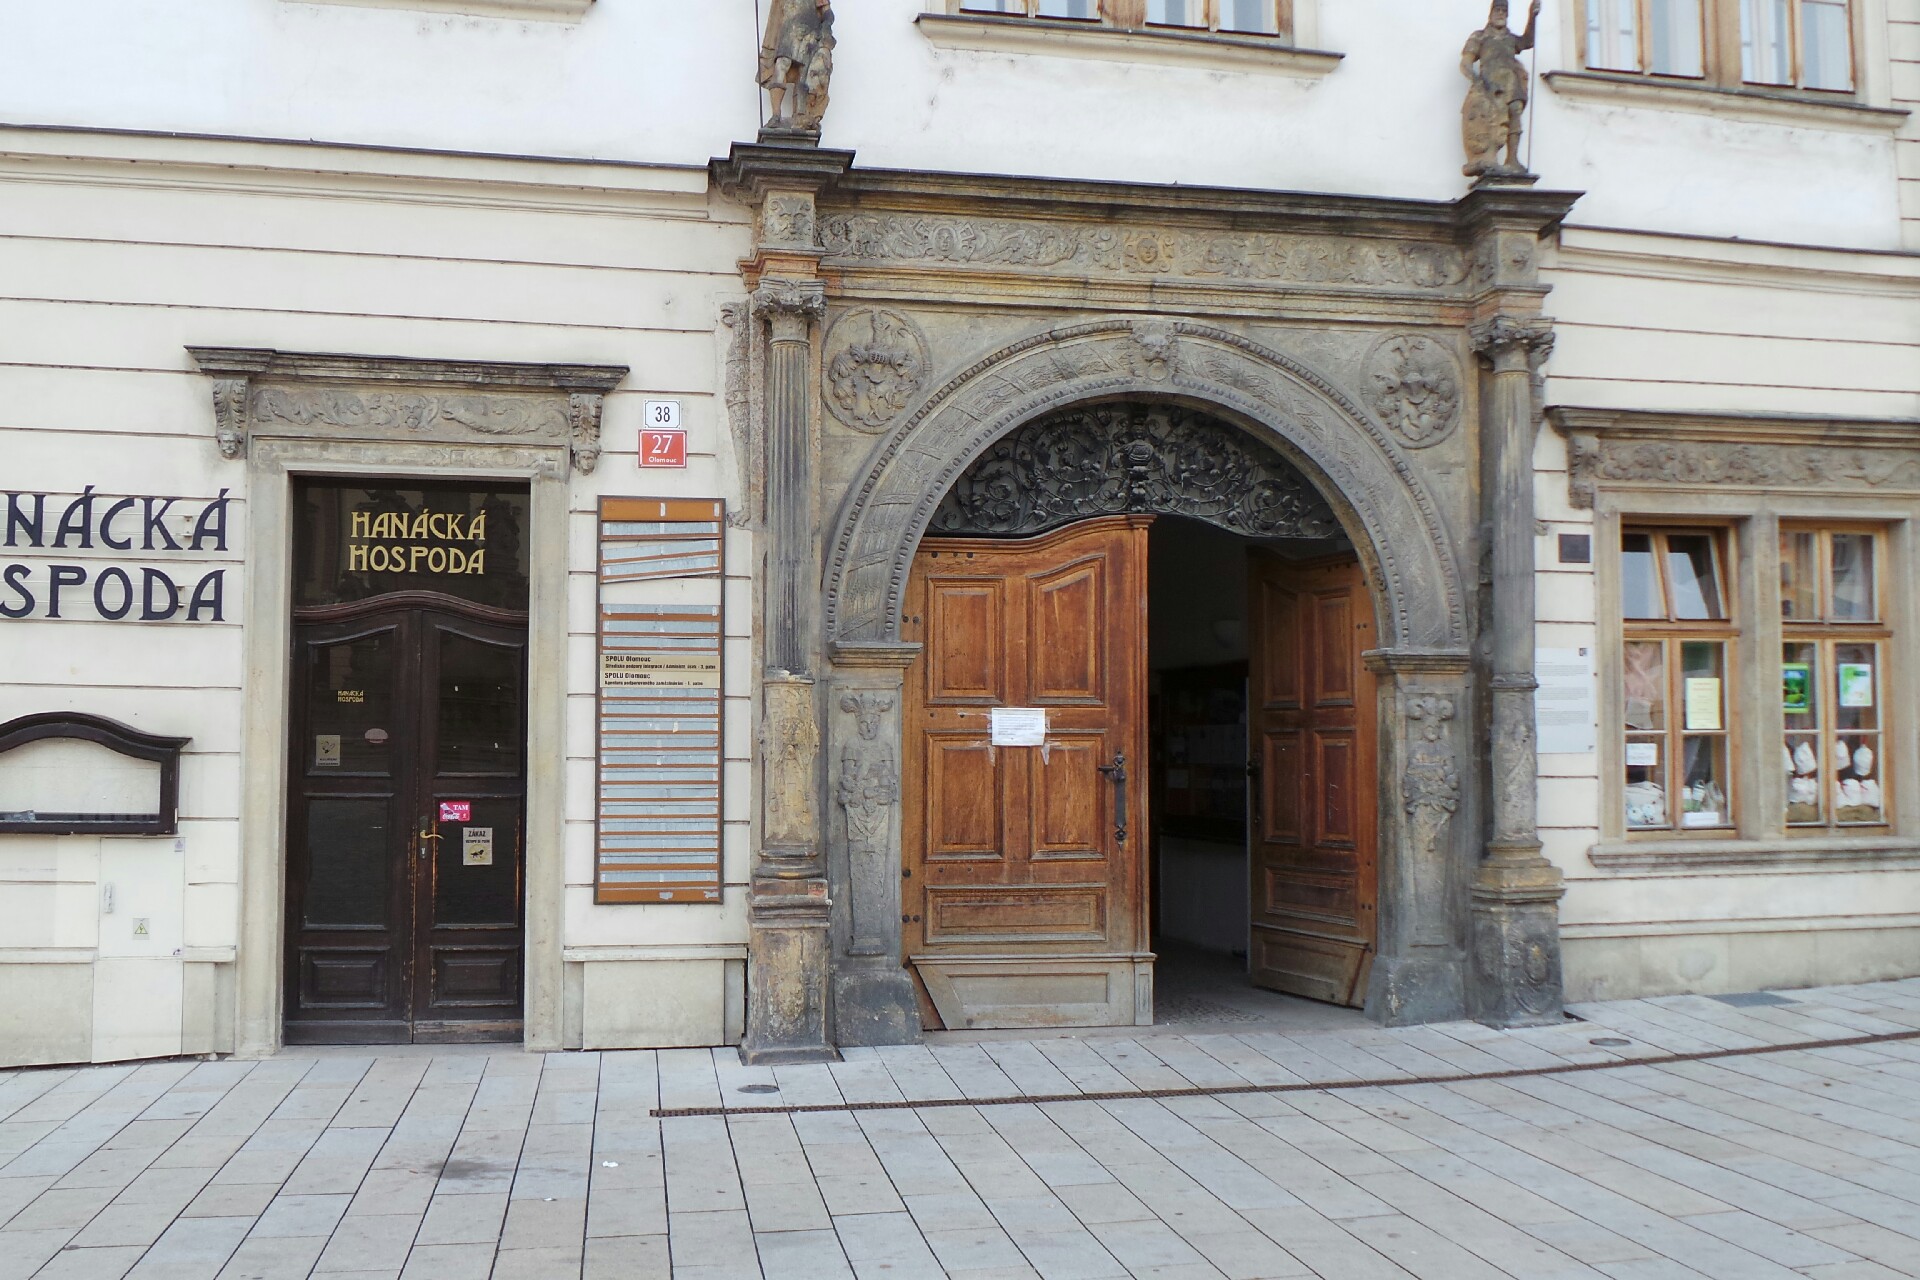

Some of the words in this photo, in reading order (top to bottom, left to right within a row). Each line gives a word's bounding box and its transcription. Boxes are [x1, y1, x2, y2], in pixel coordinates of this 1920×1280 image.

[655, 406, 671, 422] 38
[652, 434, 673, 454] 27
[3, 485, 230, 551] NÁCKÁ
[350, 508, 486, 541] HANÁCKÁ
[348, 544, 486, 575] HOSPODA
[0, 564, 226, 621] SPODA
[468, 829, 486, 837] ZÁKAZ
